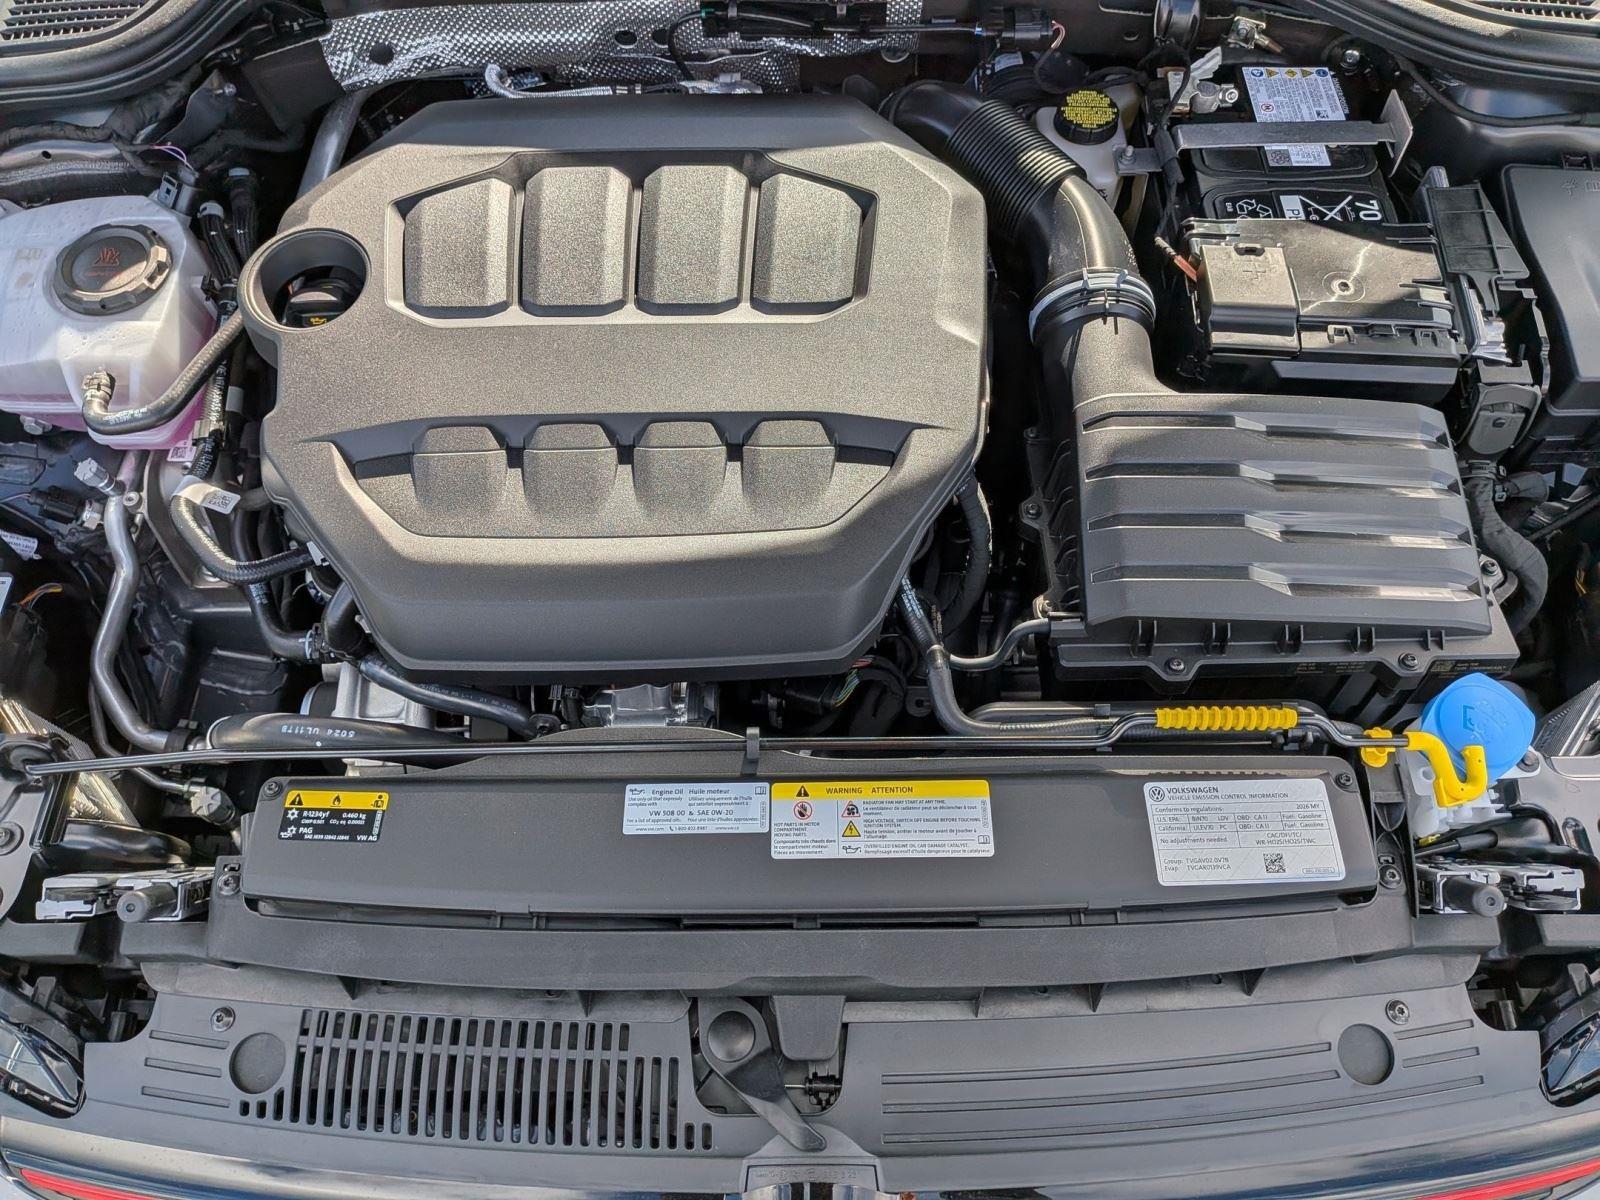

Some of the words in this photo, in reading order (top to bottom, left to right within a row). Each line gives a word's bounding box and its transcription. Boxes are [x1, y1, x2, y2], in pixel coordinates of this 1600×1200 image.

[1354, 200, 1382, 221] 70
[652, 788, 673, 796] Engine
[303, 811, 330, 819] R-1234yf
